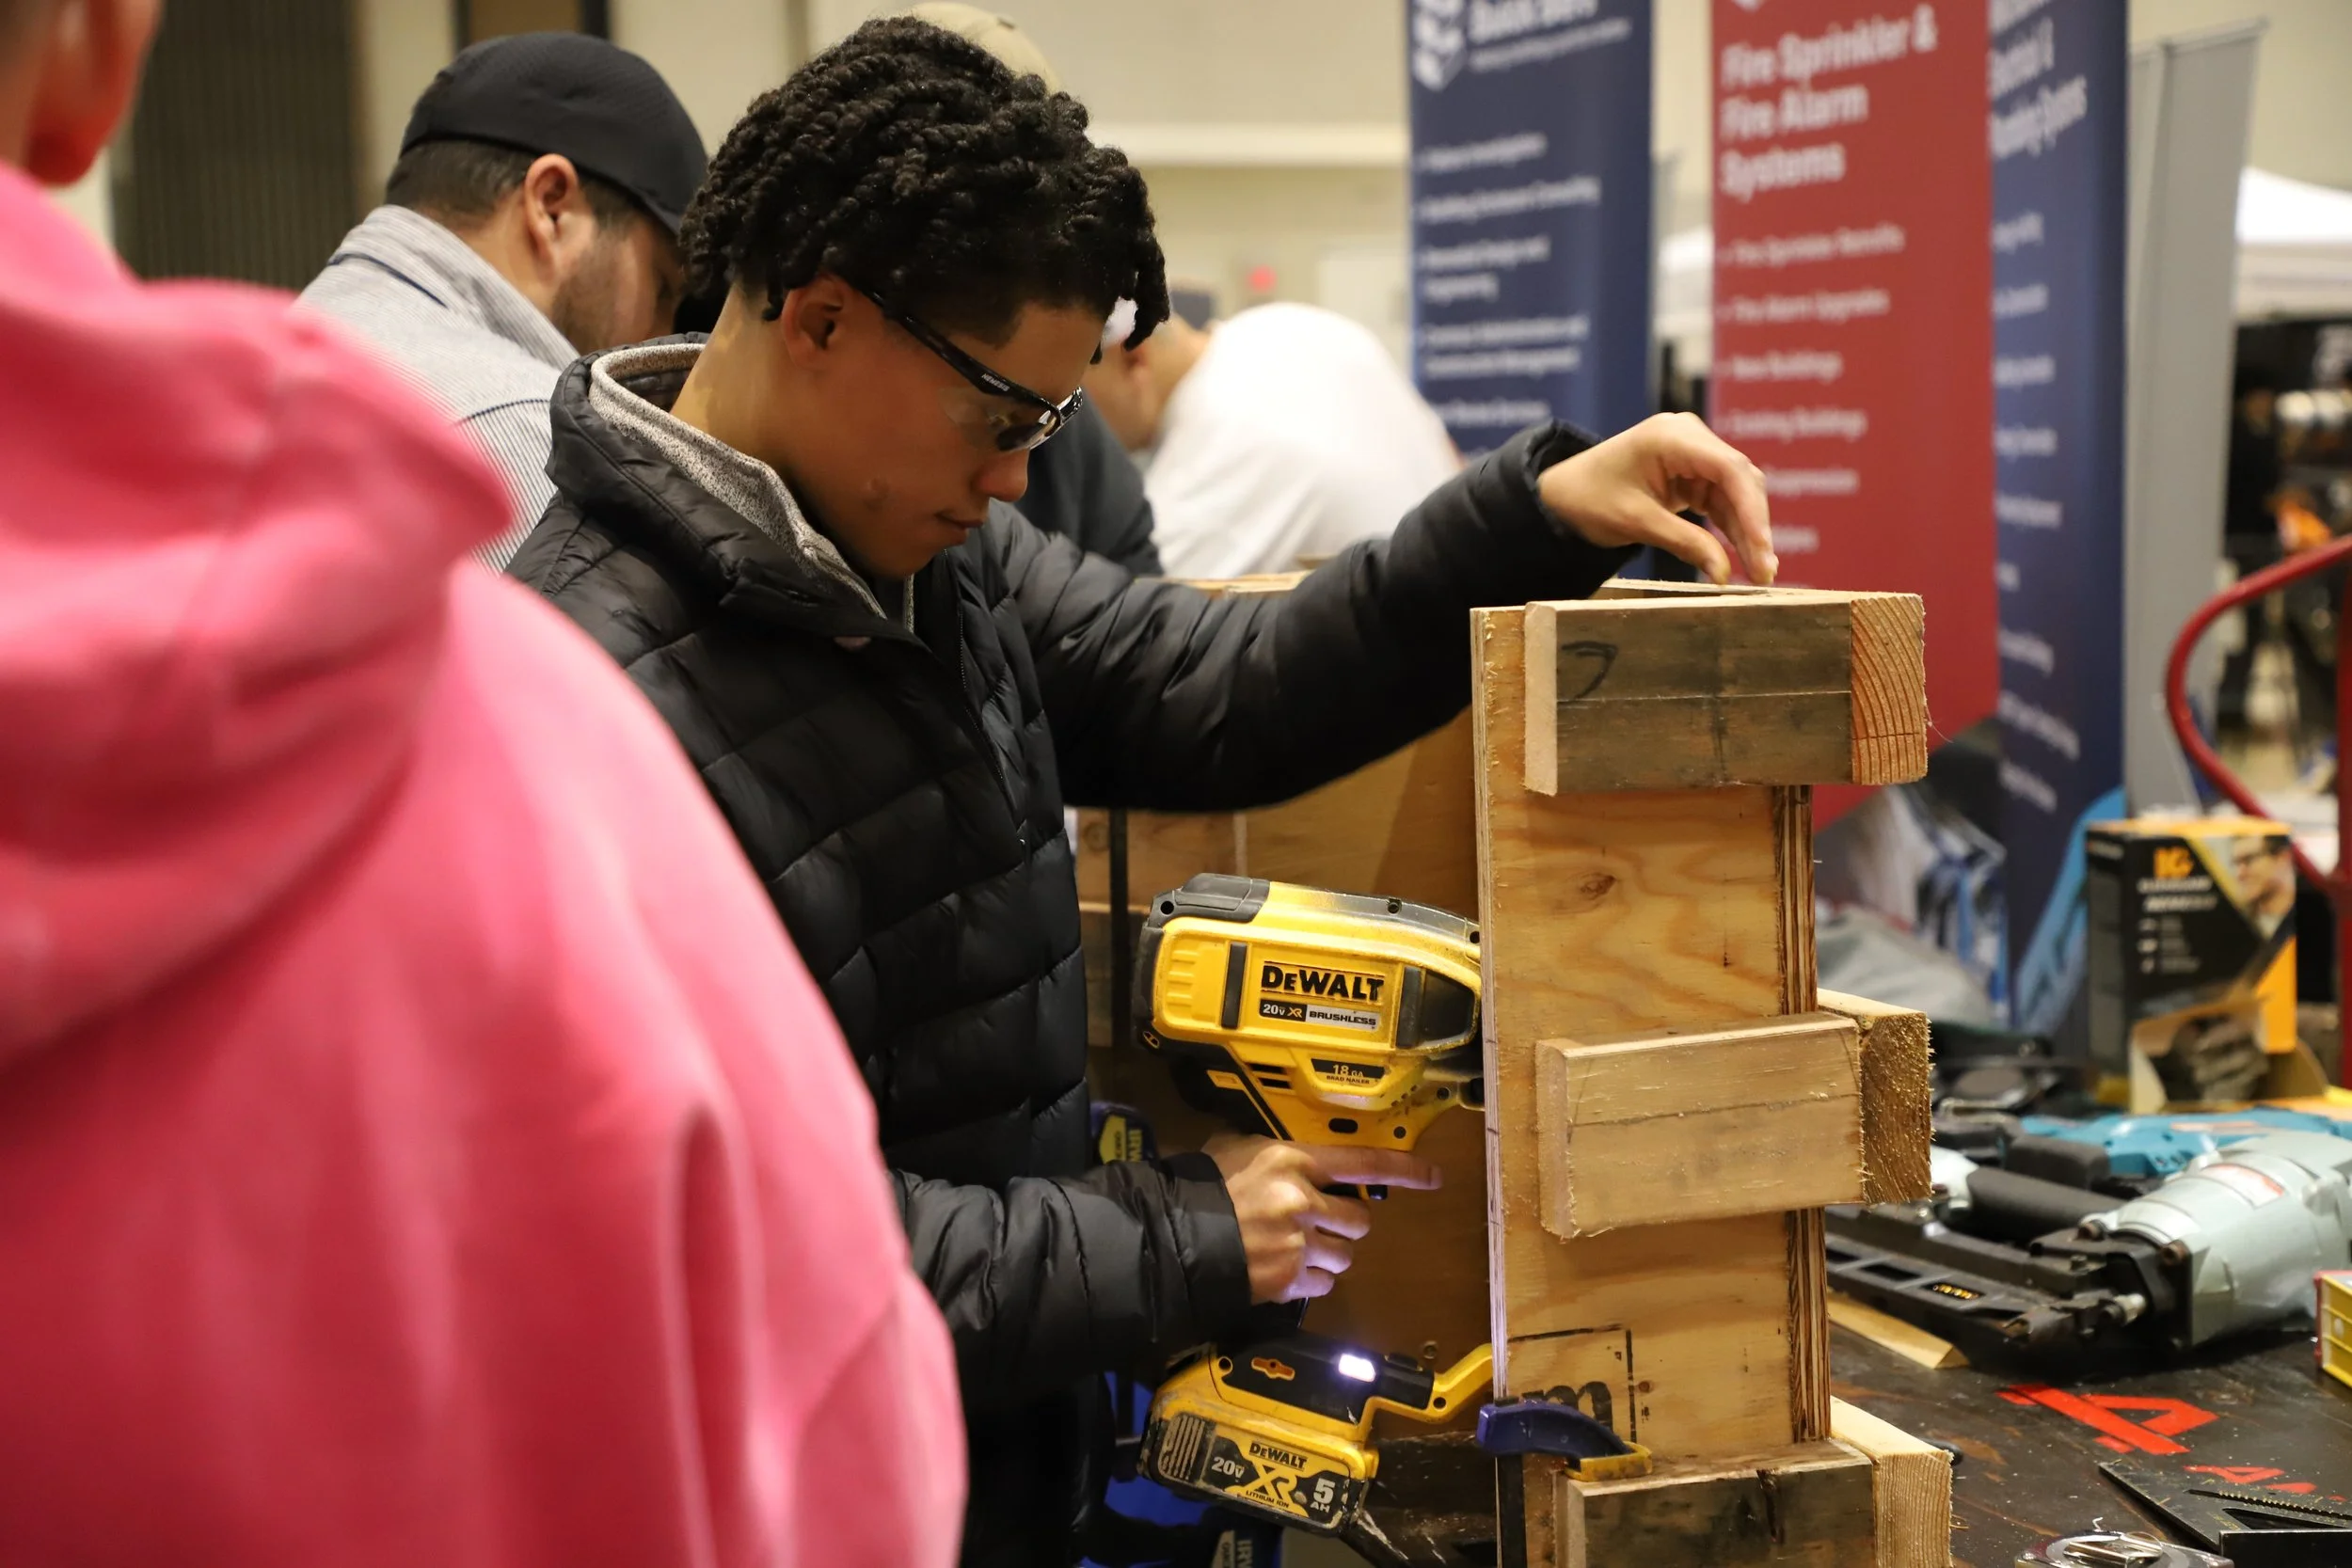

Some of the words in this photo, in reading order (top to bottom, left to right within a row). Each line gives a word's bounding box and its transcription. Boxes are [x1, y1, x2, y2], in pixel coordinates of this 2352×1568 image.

[1721, 43, 1776, 89] Fire
[1778, 16, 1909, 91] Sprinkler
[1912, 4, 1939, 53] &
[1720, 96, 1776, 142] Fire
[1779, 84, 1869, 134] Alarm
[1720, 142, 1846, 202] Systems
[981, 372, 1010, 392] NEMESIS
[1309, 1009, 1376, 1026] BRUSHLESS
[1326, 1074, 1345, 1083] BRAD
[1346, 1077, 1370, 1085] NAILER
[1332, 1064, 1349, 1077] 18
[1245, 1490, 1275, 1504] LITHIUM
[1276, 1498, 1290, 1509] ION
[1312, 1477, 1336, 1505] 5
[1310, 1501, 1331, 1513] AH
